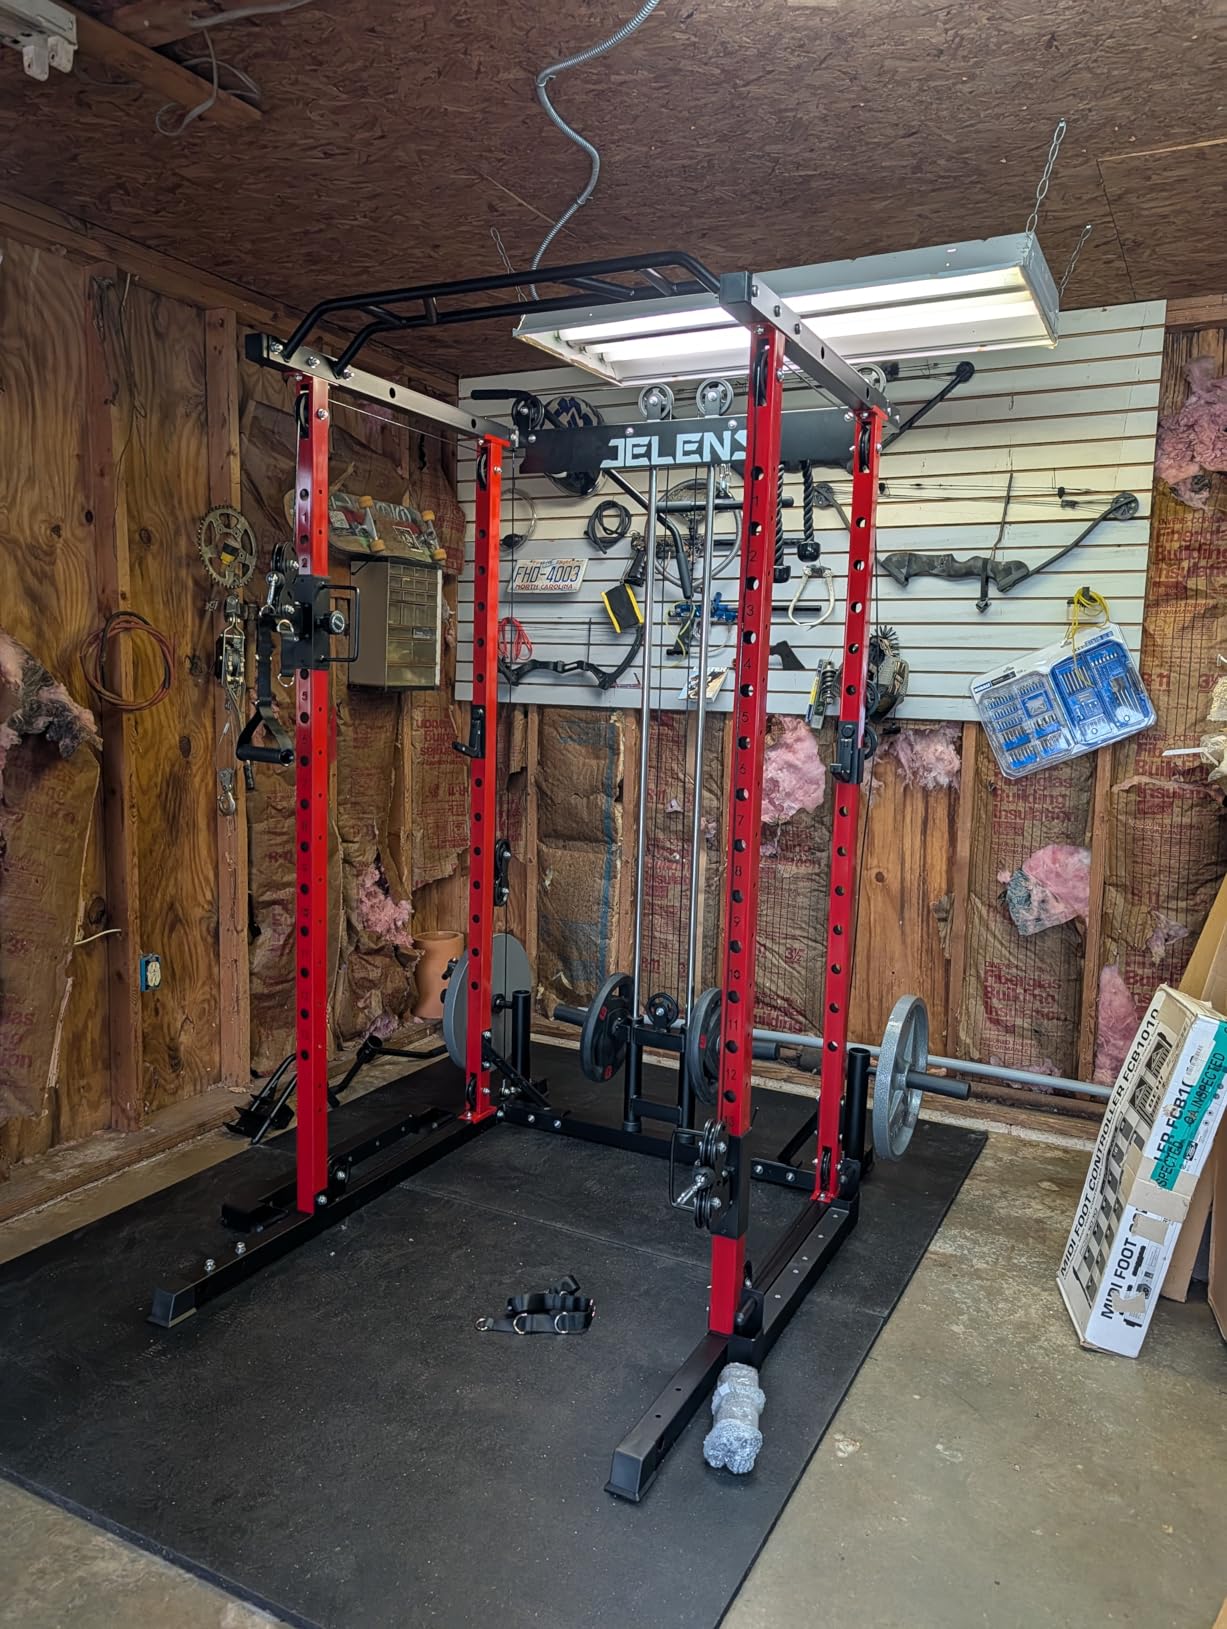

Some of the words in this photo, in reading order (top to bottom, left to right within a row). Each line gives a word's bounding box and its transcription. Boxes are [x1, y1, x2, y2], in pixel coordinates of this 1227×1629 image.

[750, 551, 757, 562] 2
[514, 565, 581, 583] FHD-4003
[540, 583, 573, 591] CAROLINA
[746, 604, 754, 617] 3
[744, 658, 751, 669] 4
[741, 711, 748, 722] 5
[739, 763, 746, 774] 6
[737, 815, 744, 825] 7
[735, 866, 742, 877] 8
[734, 916, 740, 927] 9
[729, 969, 740, 980] 10
[728, 1018, 738, 1032] 11
[726, 1068, 737, 1081] 12
[1191, 1052, 1226, 1108] INSPECTED
[1184, 1109, 1199, 1126] QA
[1060, 1238, 1076, 1276] MIDI
[1074, 1194, 1092, 1236] FOOT
[1088, 1084, 1125, 1191] CONTROLLER
[1122, 1008, 1159, 1083] FCB1010
[1113, 1237, 1137, 1280] FOOT
